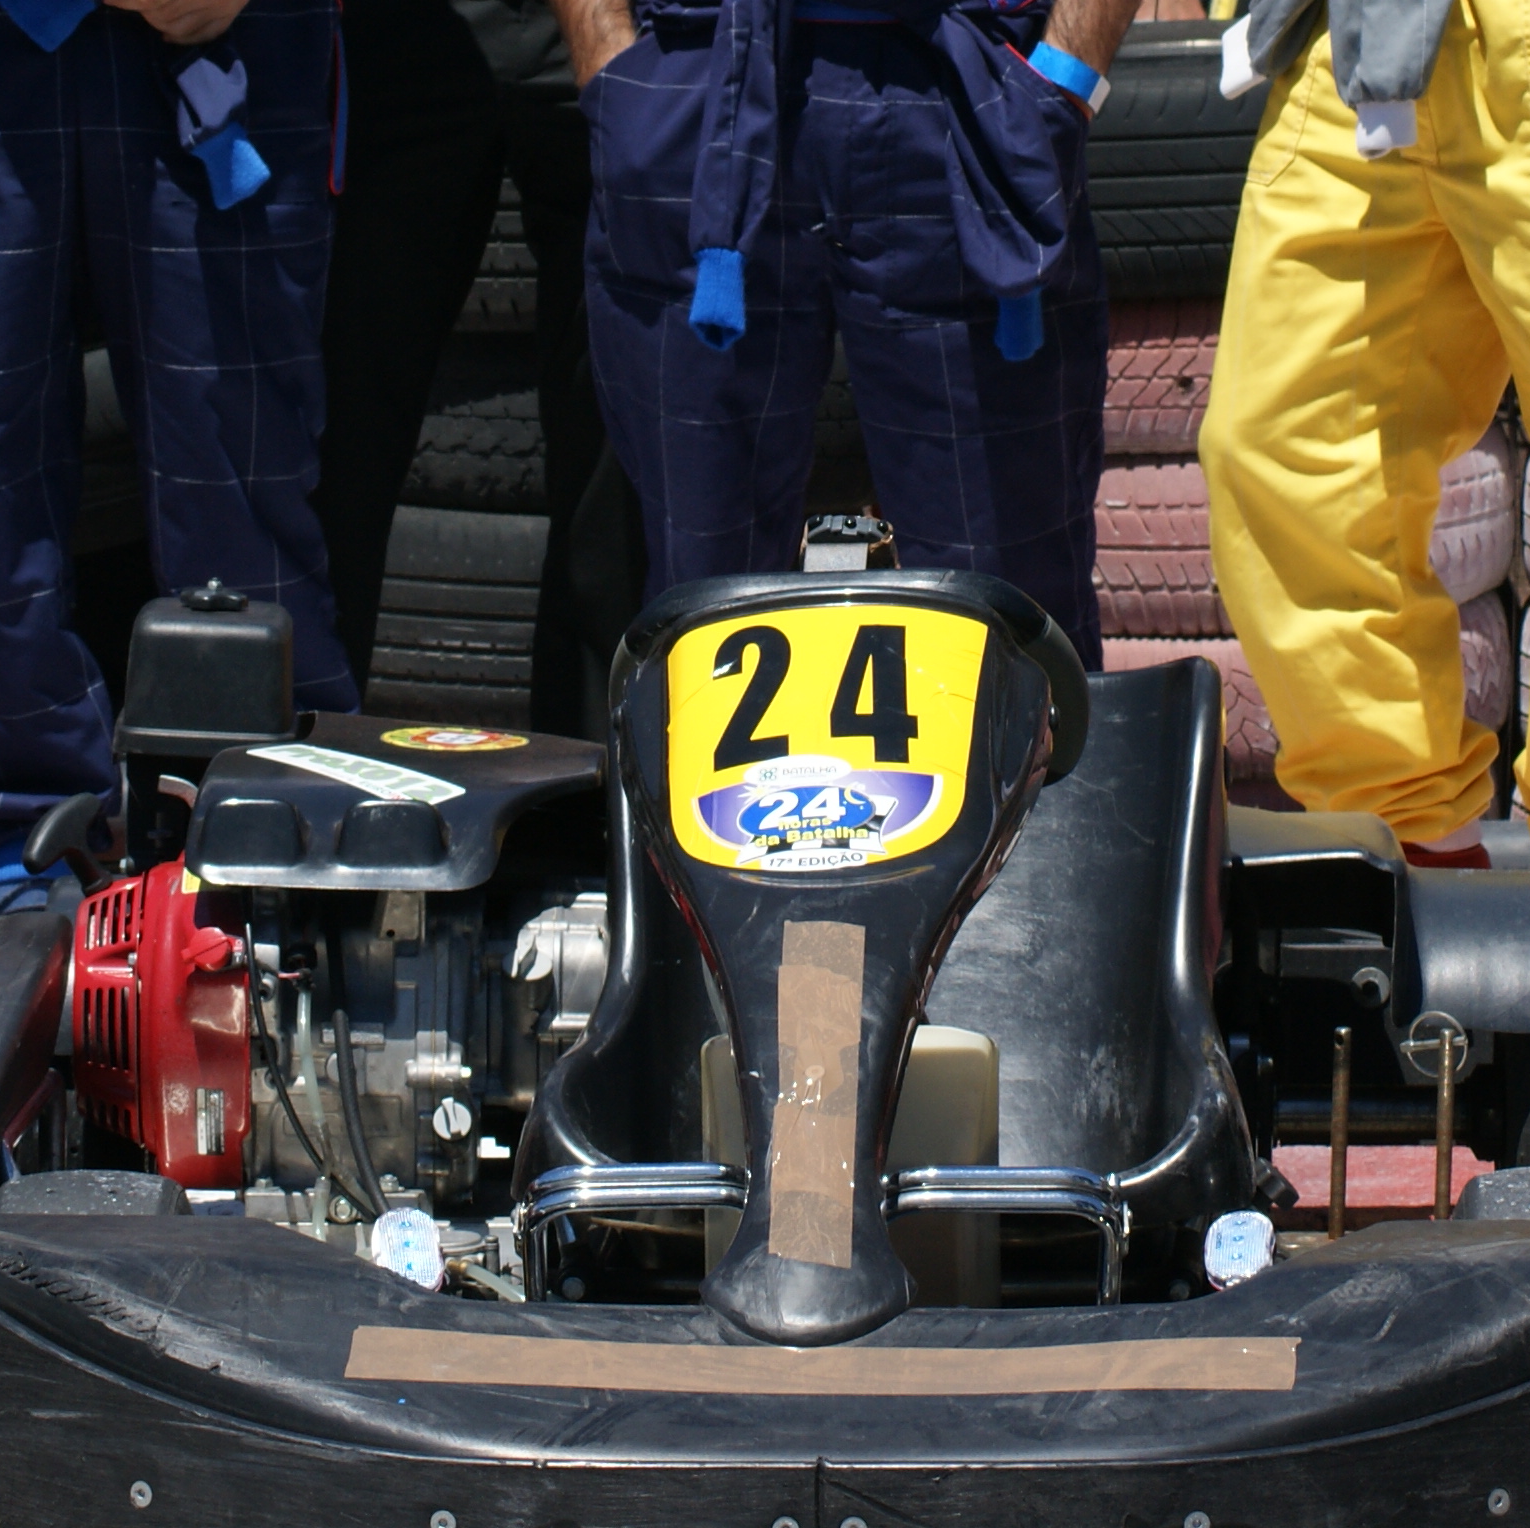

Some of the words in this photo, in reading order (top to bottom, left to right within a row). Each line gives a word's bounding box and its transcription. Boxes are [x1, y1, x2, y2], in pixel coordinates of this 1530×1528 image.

[713, 624, 918, 773] 24
[782, 765, 838, 776] BATALHA
[759, 787, 846, 831] 24
[754, 832, 781, 848] da
[787, 826, 869, 844] Batalha
[798, 852, 864, 867] EDIÇÃO
